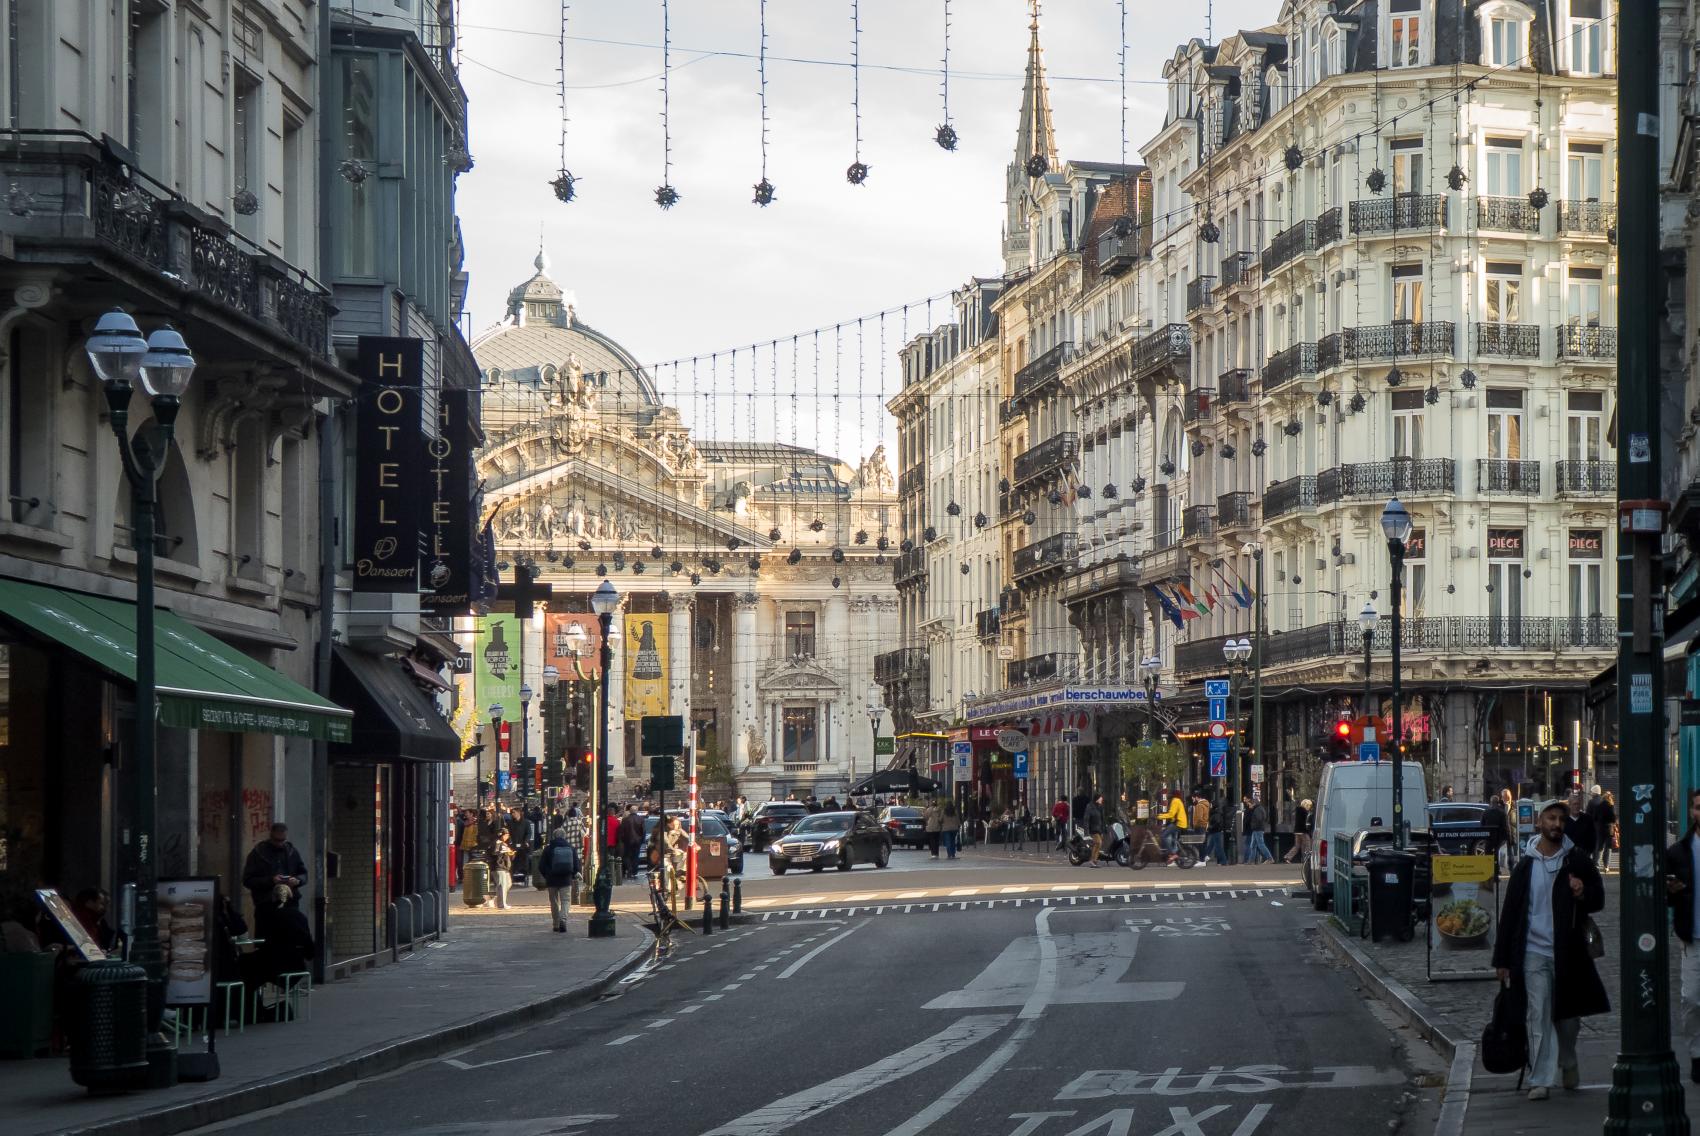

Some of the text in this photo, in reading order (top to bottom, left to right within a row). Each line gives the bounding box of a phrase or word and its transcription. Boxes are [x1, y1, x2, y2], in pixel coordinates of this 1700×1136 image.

[378, 353, 403, 524] HOTEL
[356, 559, 416, 578] Dansaert
[980, 729, 991, 737] LE
[1016, 754, 1026, 769] P
[1053, 1064, 1290, 1100] BUS
